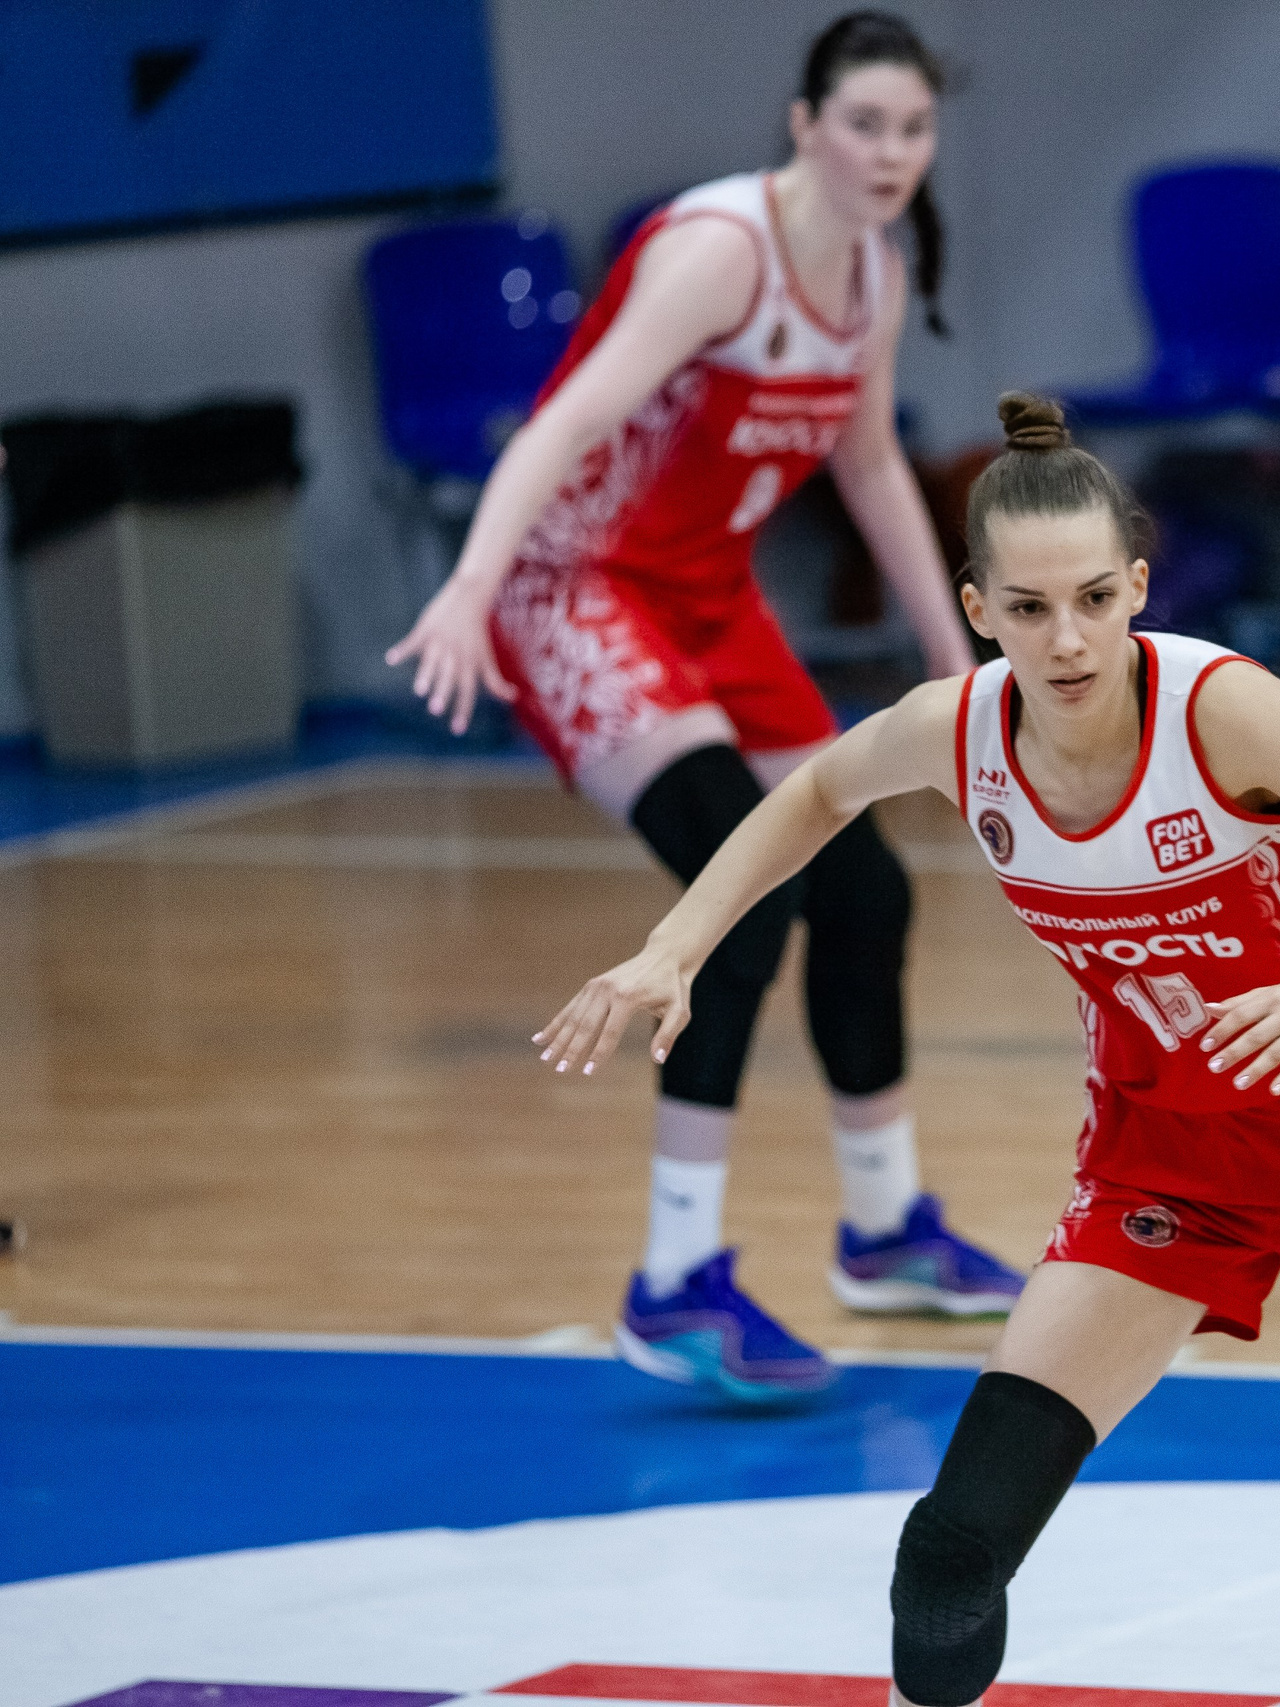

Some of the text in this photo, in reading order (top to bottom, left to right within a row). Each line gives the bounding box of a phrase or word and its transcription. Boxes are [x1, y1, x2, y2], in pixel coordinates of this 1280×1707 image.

[1152, 814, 1200, 846] FON
[1159, 833, 1206, 867] BET
[1165, 896, 1223, 926] КЛУБ
[1039, 930, 1245, 971] НОСТЬ
[1112, 971, 1211, 1053] 15
